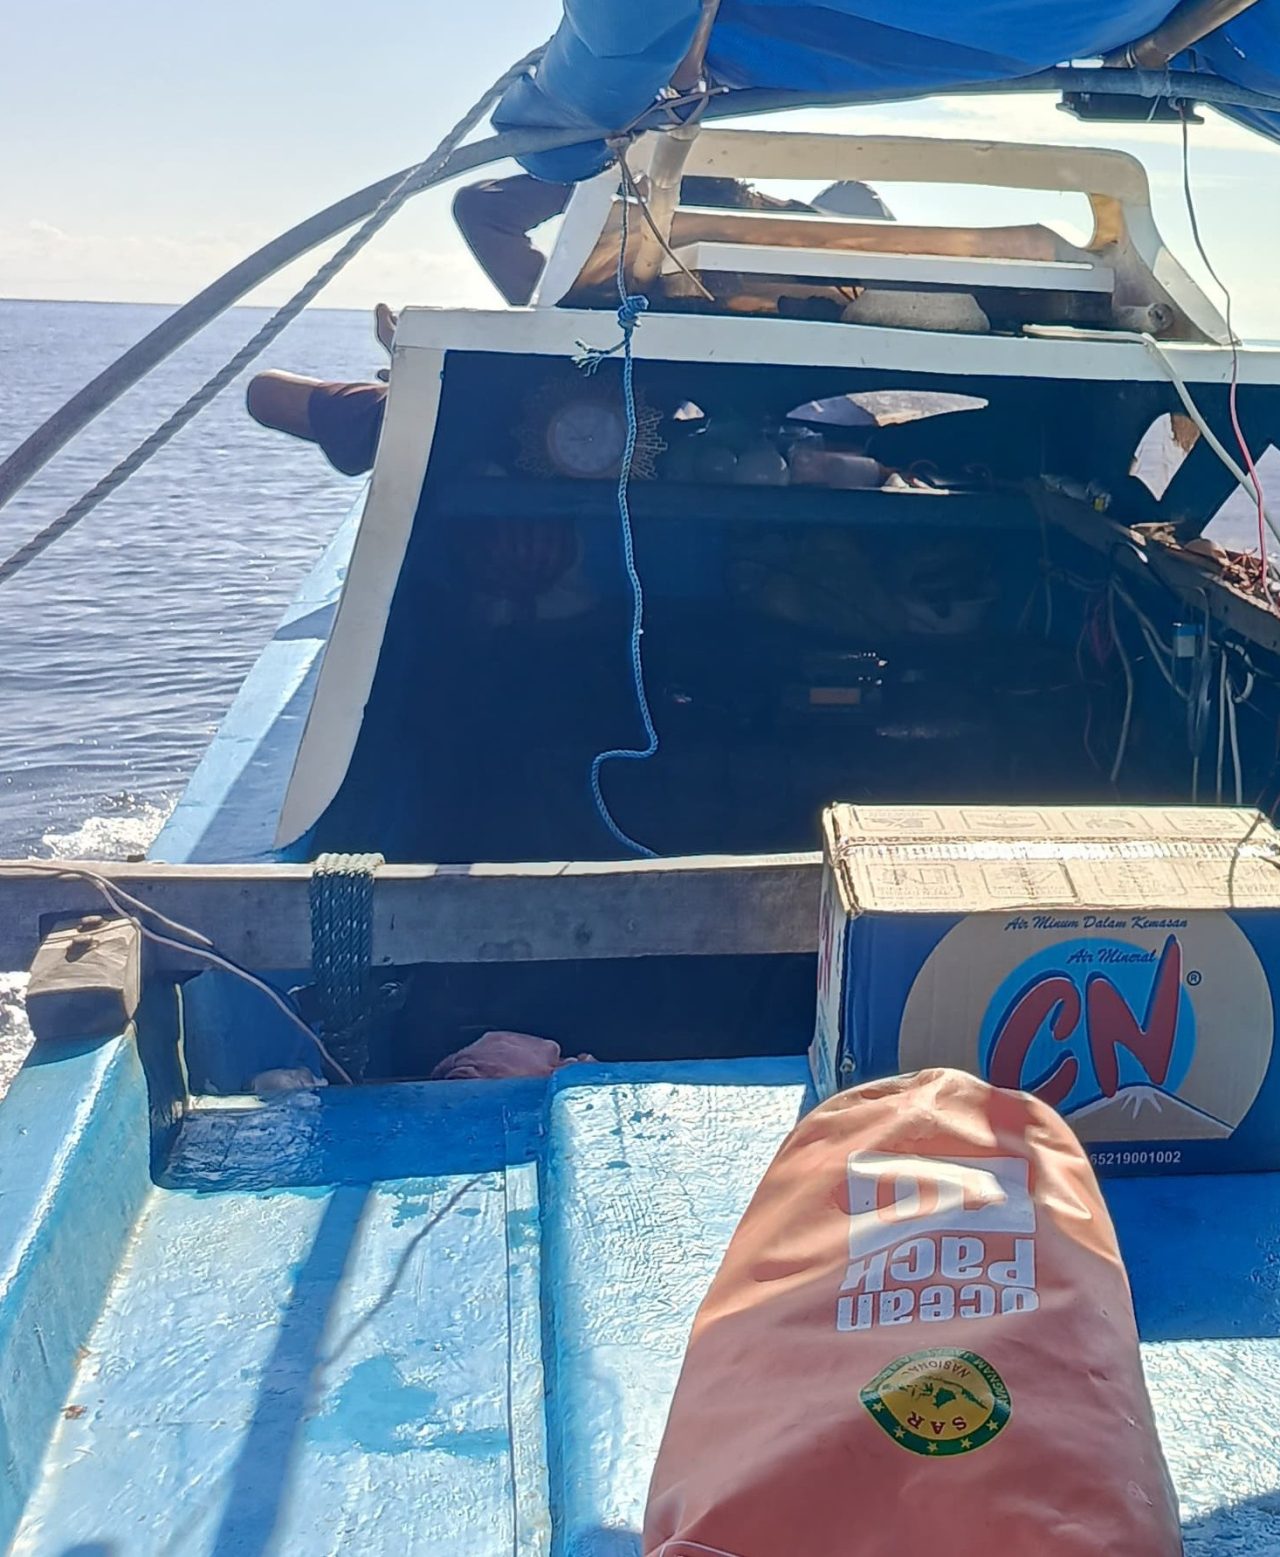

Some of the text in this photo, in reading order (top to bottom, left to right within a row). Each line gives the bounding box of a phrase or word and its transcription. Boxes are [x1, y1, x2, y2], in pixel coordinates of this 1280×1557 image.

[1004, 915, 1187, 931] Air Minum Dalam Kemasan
[1066, 948, 1157, 964] Air Mineral
[986, 933, 1182, 1101] CN
[906, 1411, 968, 1436] SAR
